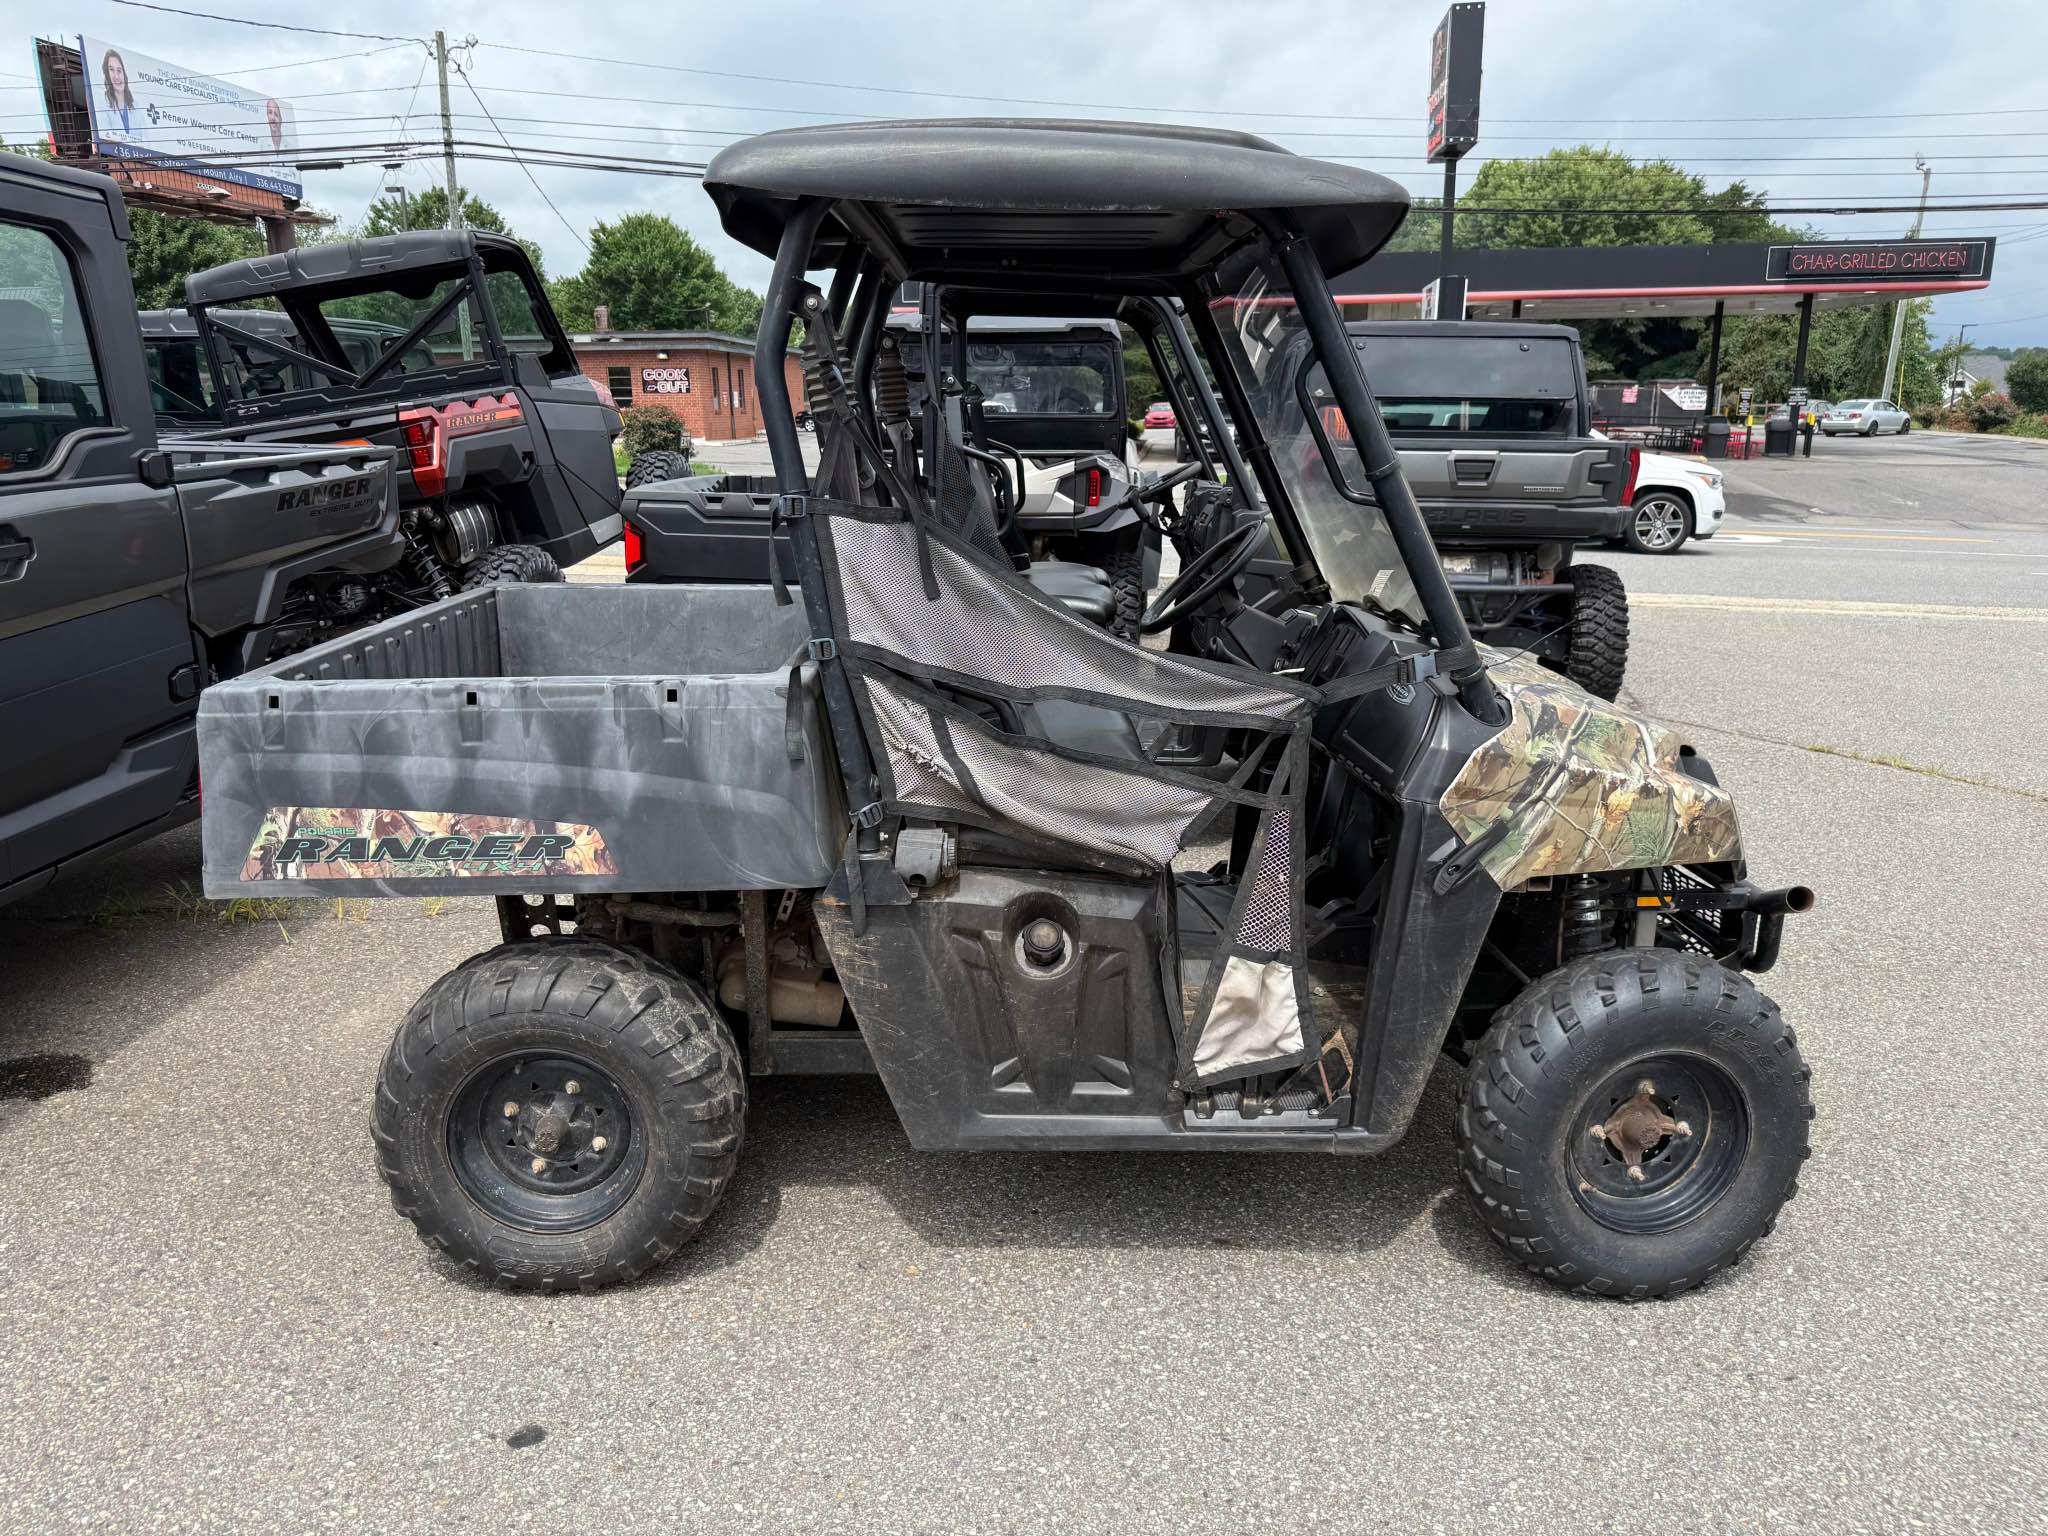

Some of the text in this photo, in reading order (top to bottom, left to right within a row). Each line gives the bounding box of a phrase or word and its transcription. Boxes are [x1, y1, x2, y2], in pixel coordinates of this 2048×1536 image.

[137, 71, 164, 87] WOUND
[165, 80, 181, 91] CARE
[182, 84, 219, 102] SPECIALISTS
[188, 78, 210, 91] BOARD
[210, 85, 239, 100] CERTIFIED
[162, 111, 258, 144] Renew Wound Care Center
[203, 168, 226, 179] Mount
[229, 172, 242, 183] Airy
[1792, 250, 1968, 272] CHAR-GRILLED CHICKEN
[643, 368, 688, 381] COOK
[450, 412, 497, 428] RANGER
[276, 477, 371, 513] RANGER
[1427, 508, 1527, 526] OLARIS
[298, 827, 355, 836] POLARIS
[273, 835, 577, 863] RANGER
